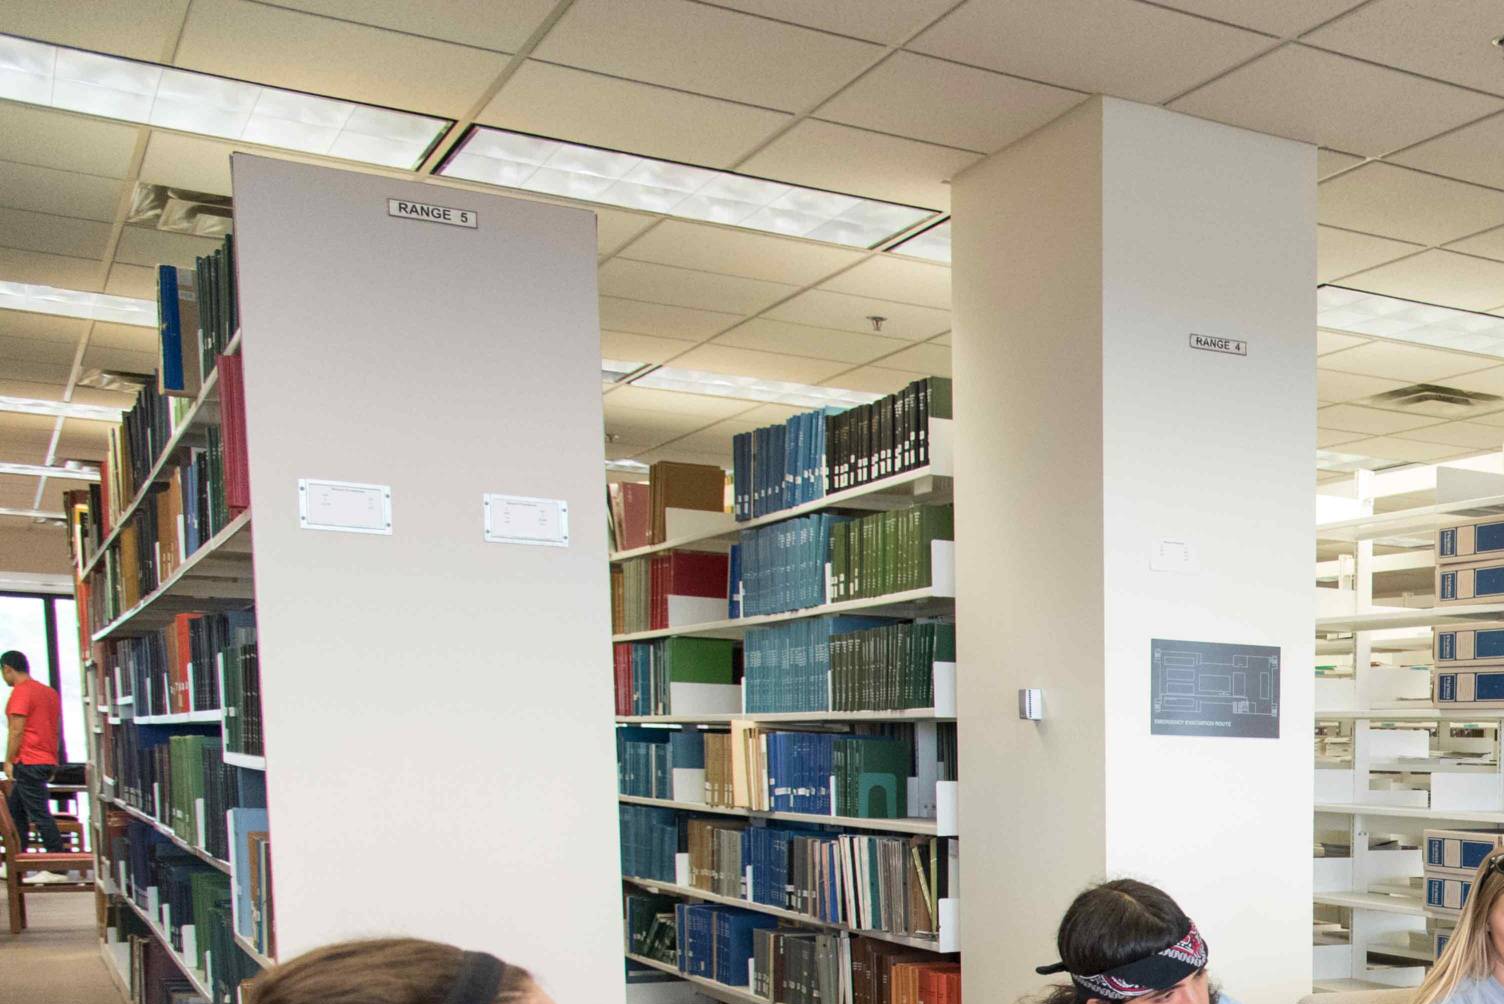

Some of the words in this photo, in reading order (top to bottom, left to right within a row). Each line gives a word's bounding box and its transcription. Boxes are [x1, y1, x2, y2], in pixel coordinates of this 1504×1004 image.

[398, 203, 452, 221] RANGE
[460, 212, 468, 224] 5
[1195, 336, 1231, 350] RANGE
[1235, 343, 1240, 351] 4
